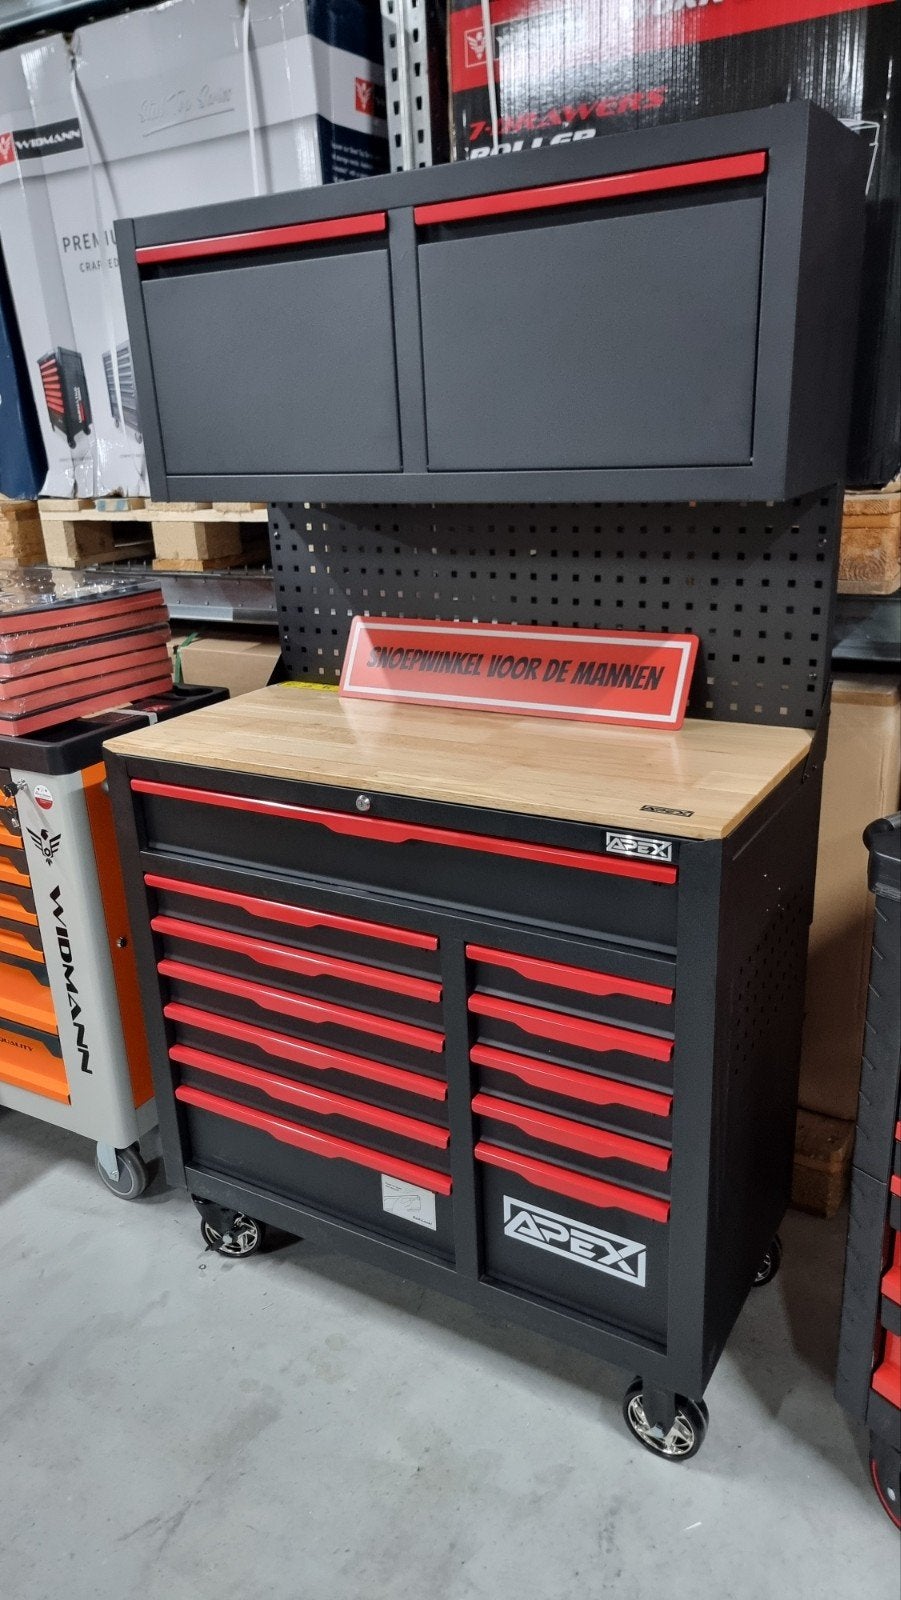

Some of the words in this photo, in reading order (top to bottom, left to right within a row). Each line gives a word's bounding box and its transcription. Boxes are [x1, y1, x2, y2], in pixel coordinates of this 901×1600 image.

[15, 129, 80, 150] WIDMANN
[366, 645, 481, 677] SNOEPWINKEL
[486, 654, 542, 681] VOOR
[543, 659, 572, 683] DE
[570, 660, 665, 691] MANNEN
[606, 834, 672, 860] APEX
[49, 884, 93, 1075] WIDMANN
[504, 1204, 646, 1282] APEX
